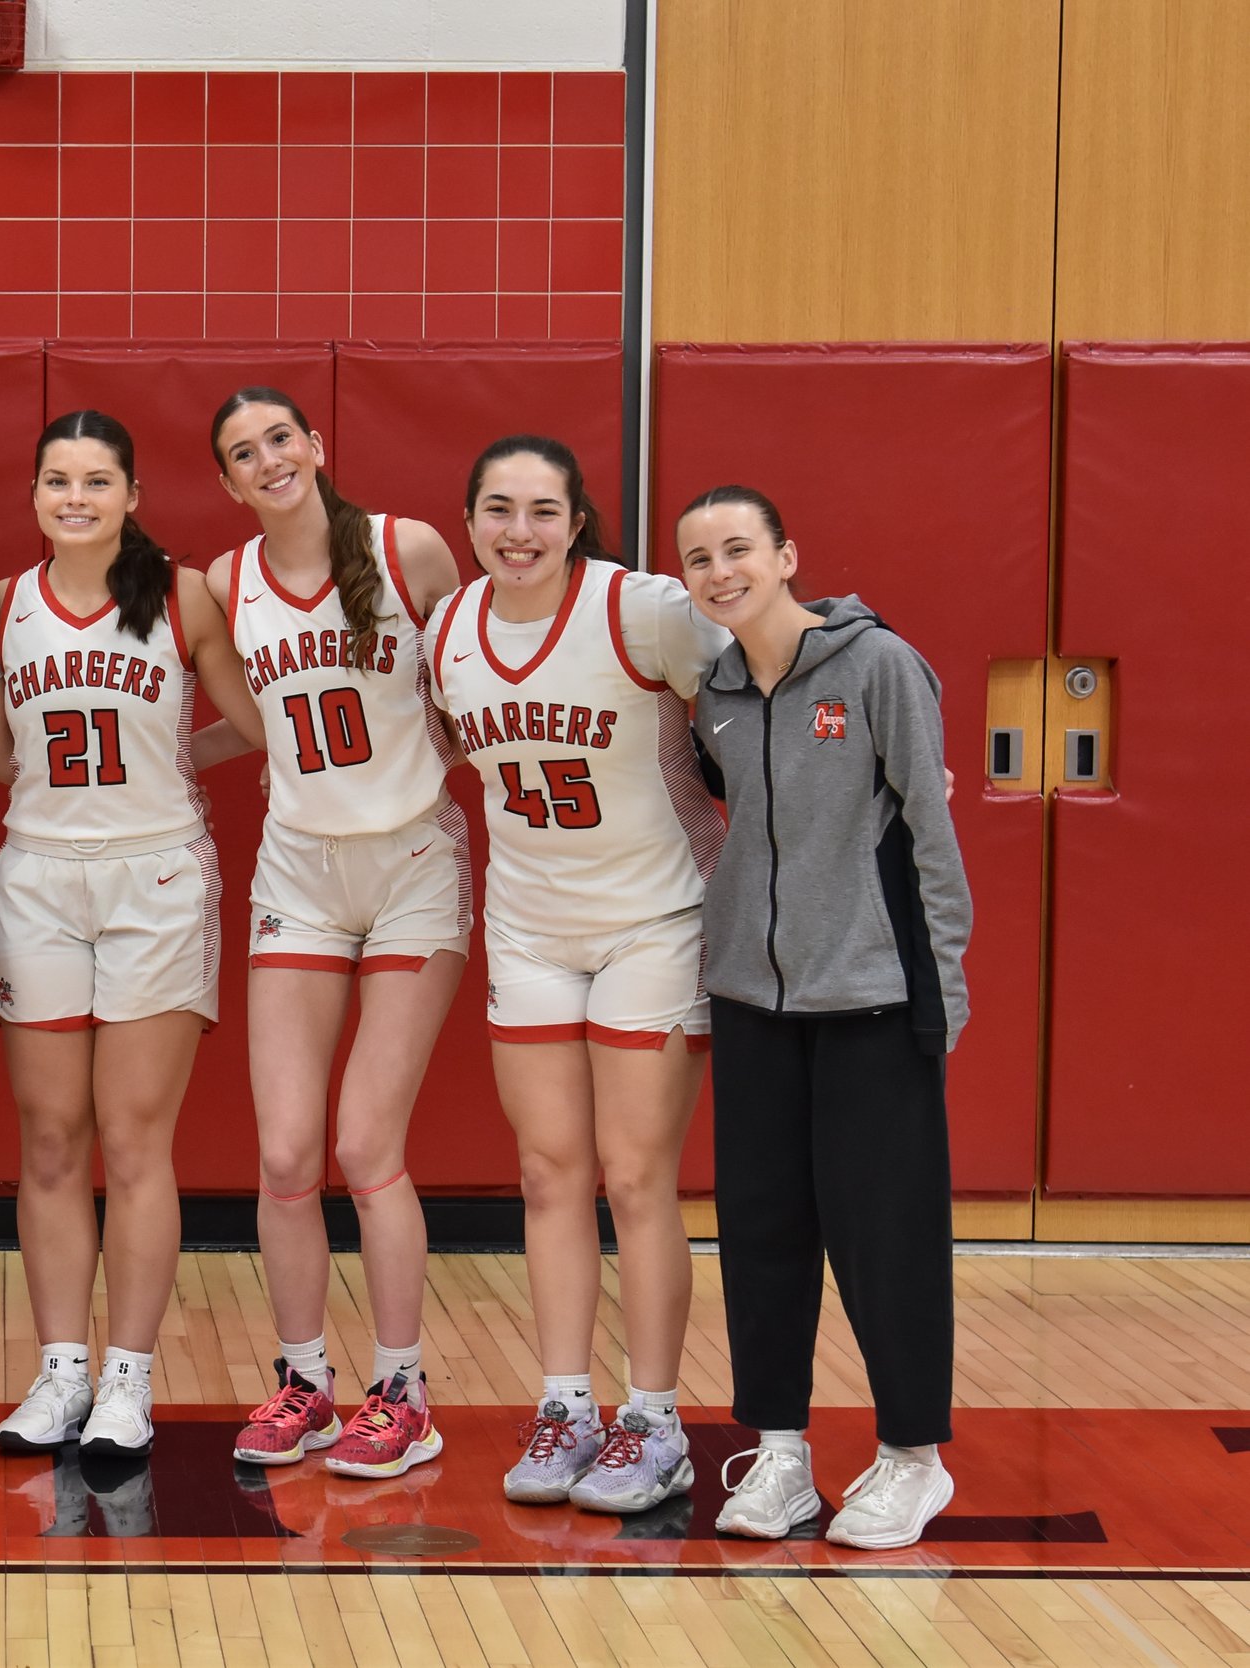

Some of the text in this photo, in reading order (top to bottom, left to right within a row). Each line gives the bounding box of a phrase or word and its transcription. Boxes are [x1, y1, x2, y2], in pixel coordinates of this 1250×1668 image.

[7, 650, 166, 709] CHARGERS
[245, 630, 397, 695] CHARGERS
[42, 708, 127, 788] 21
[282, 687, 373, 775] 10
[455, 701, 618, 756] CHARGERS
[498, 758, 602, 830] 45
